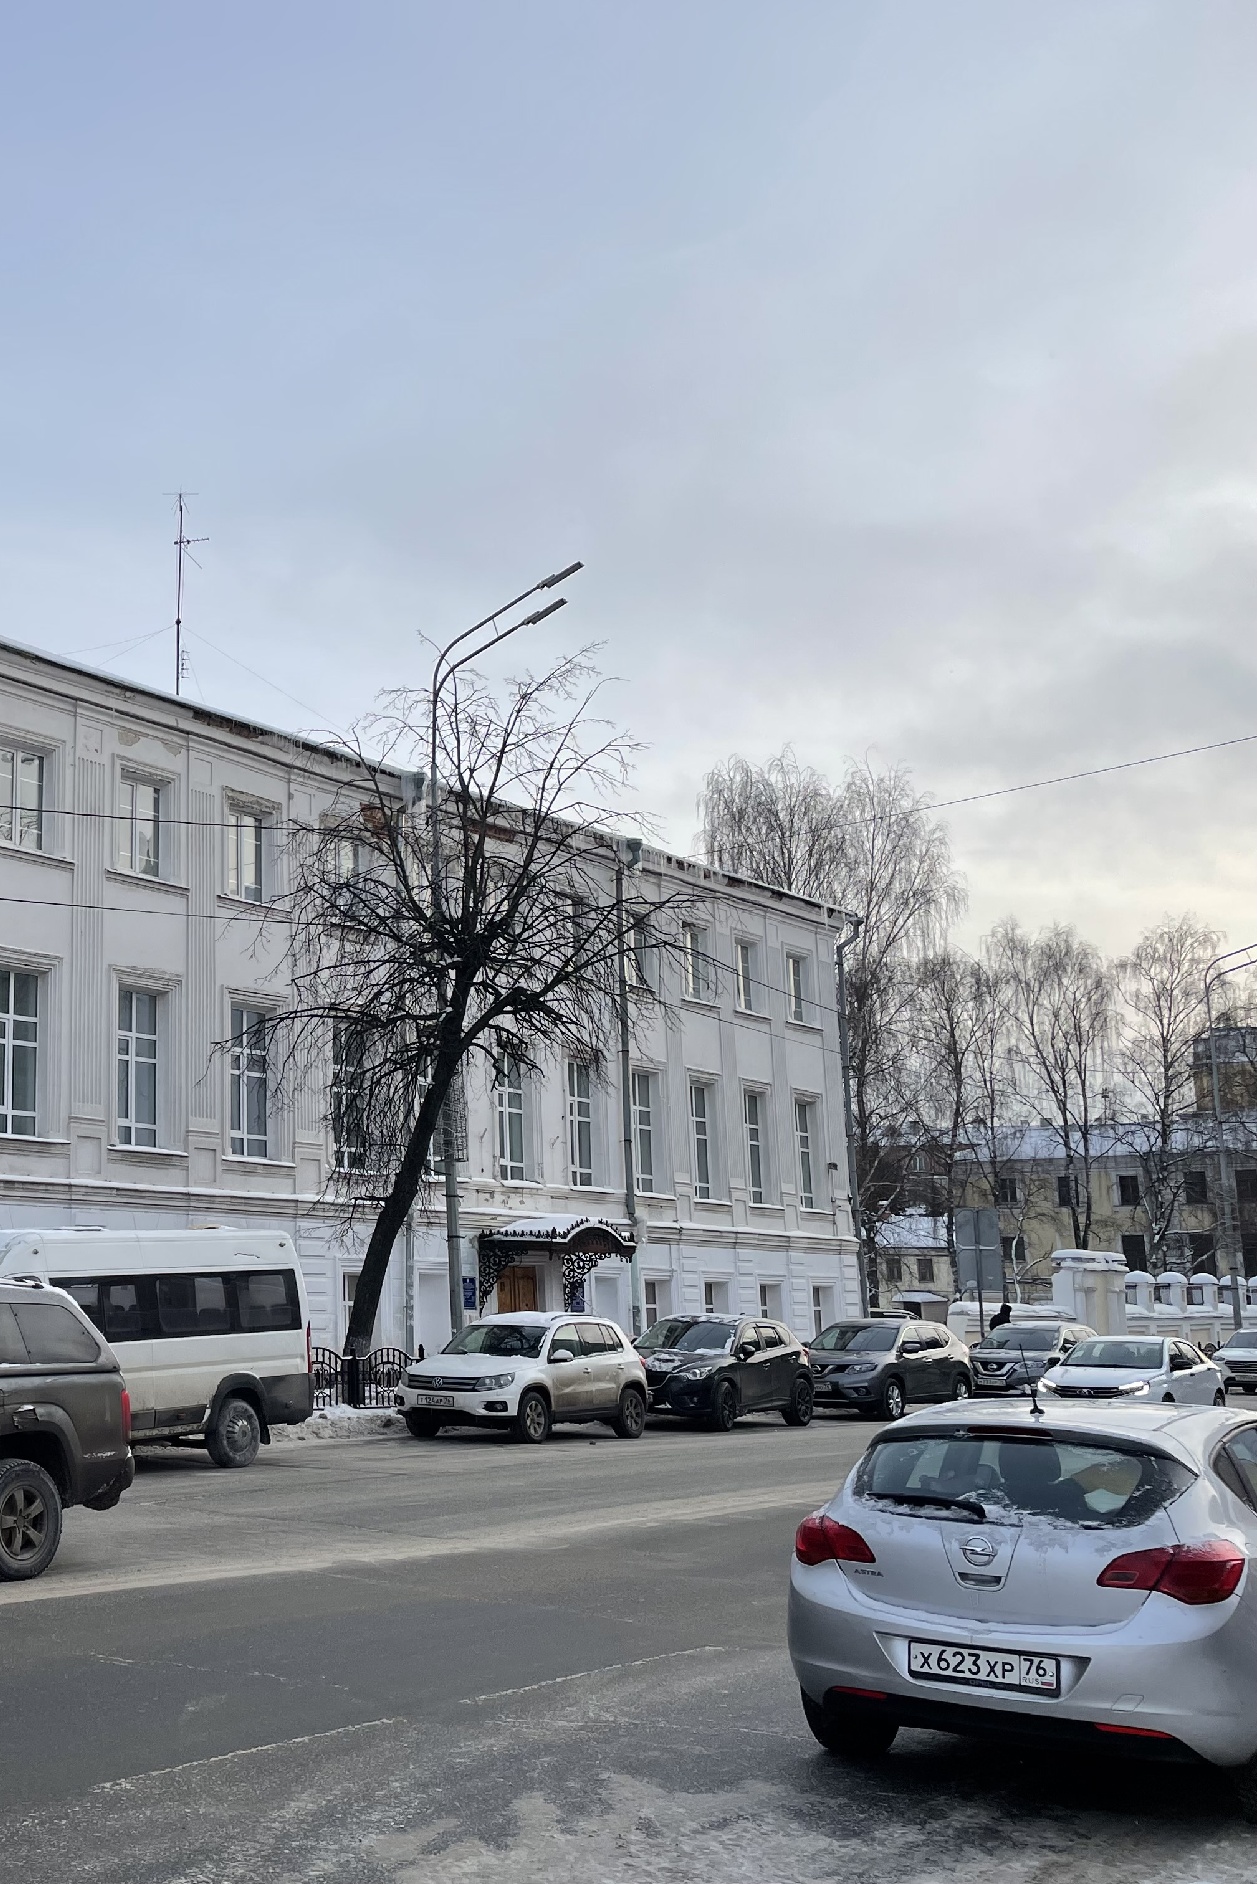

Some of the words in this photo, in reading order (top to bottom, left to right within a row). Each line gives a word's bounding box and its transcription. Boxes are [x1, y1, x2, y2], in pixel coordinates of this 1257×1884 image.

[853, 1568, 884, 1578] ASTRA
[1022, 1657, 1047, 1678] 76
[1022, 1677, 1040, 1686] RUS
